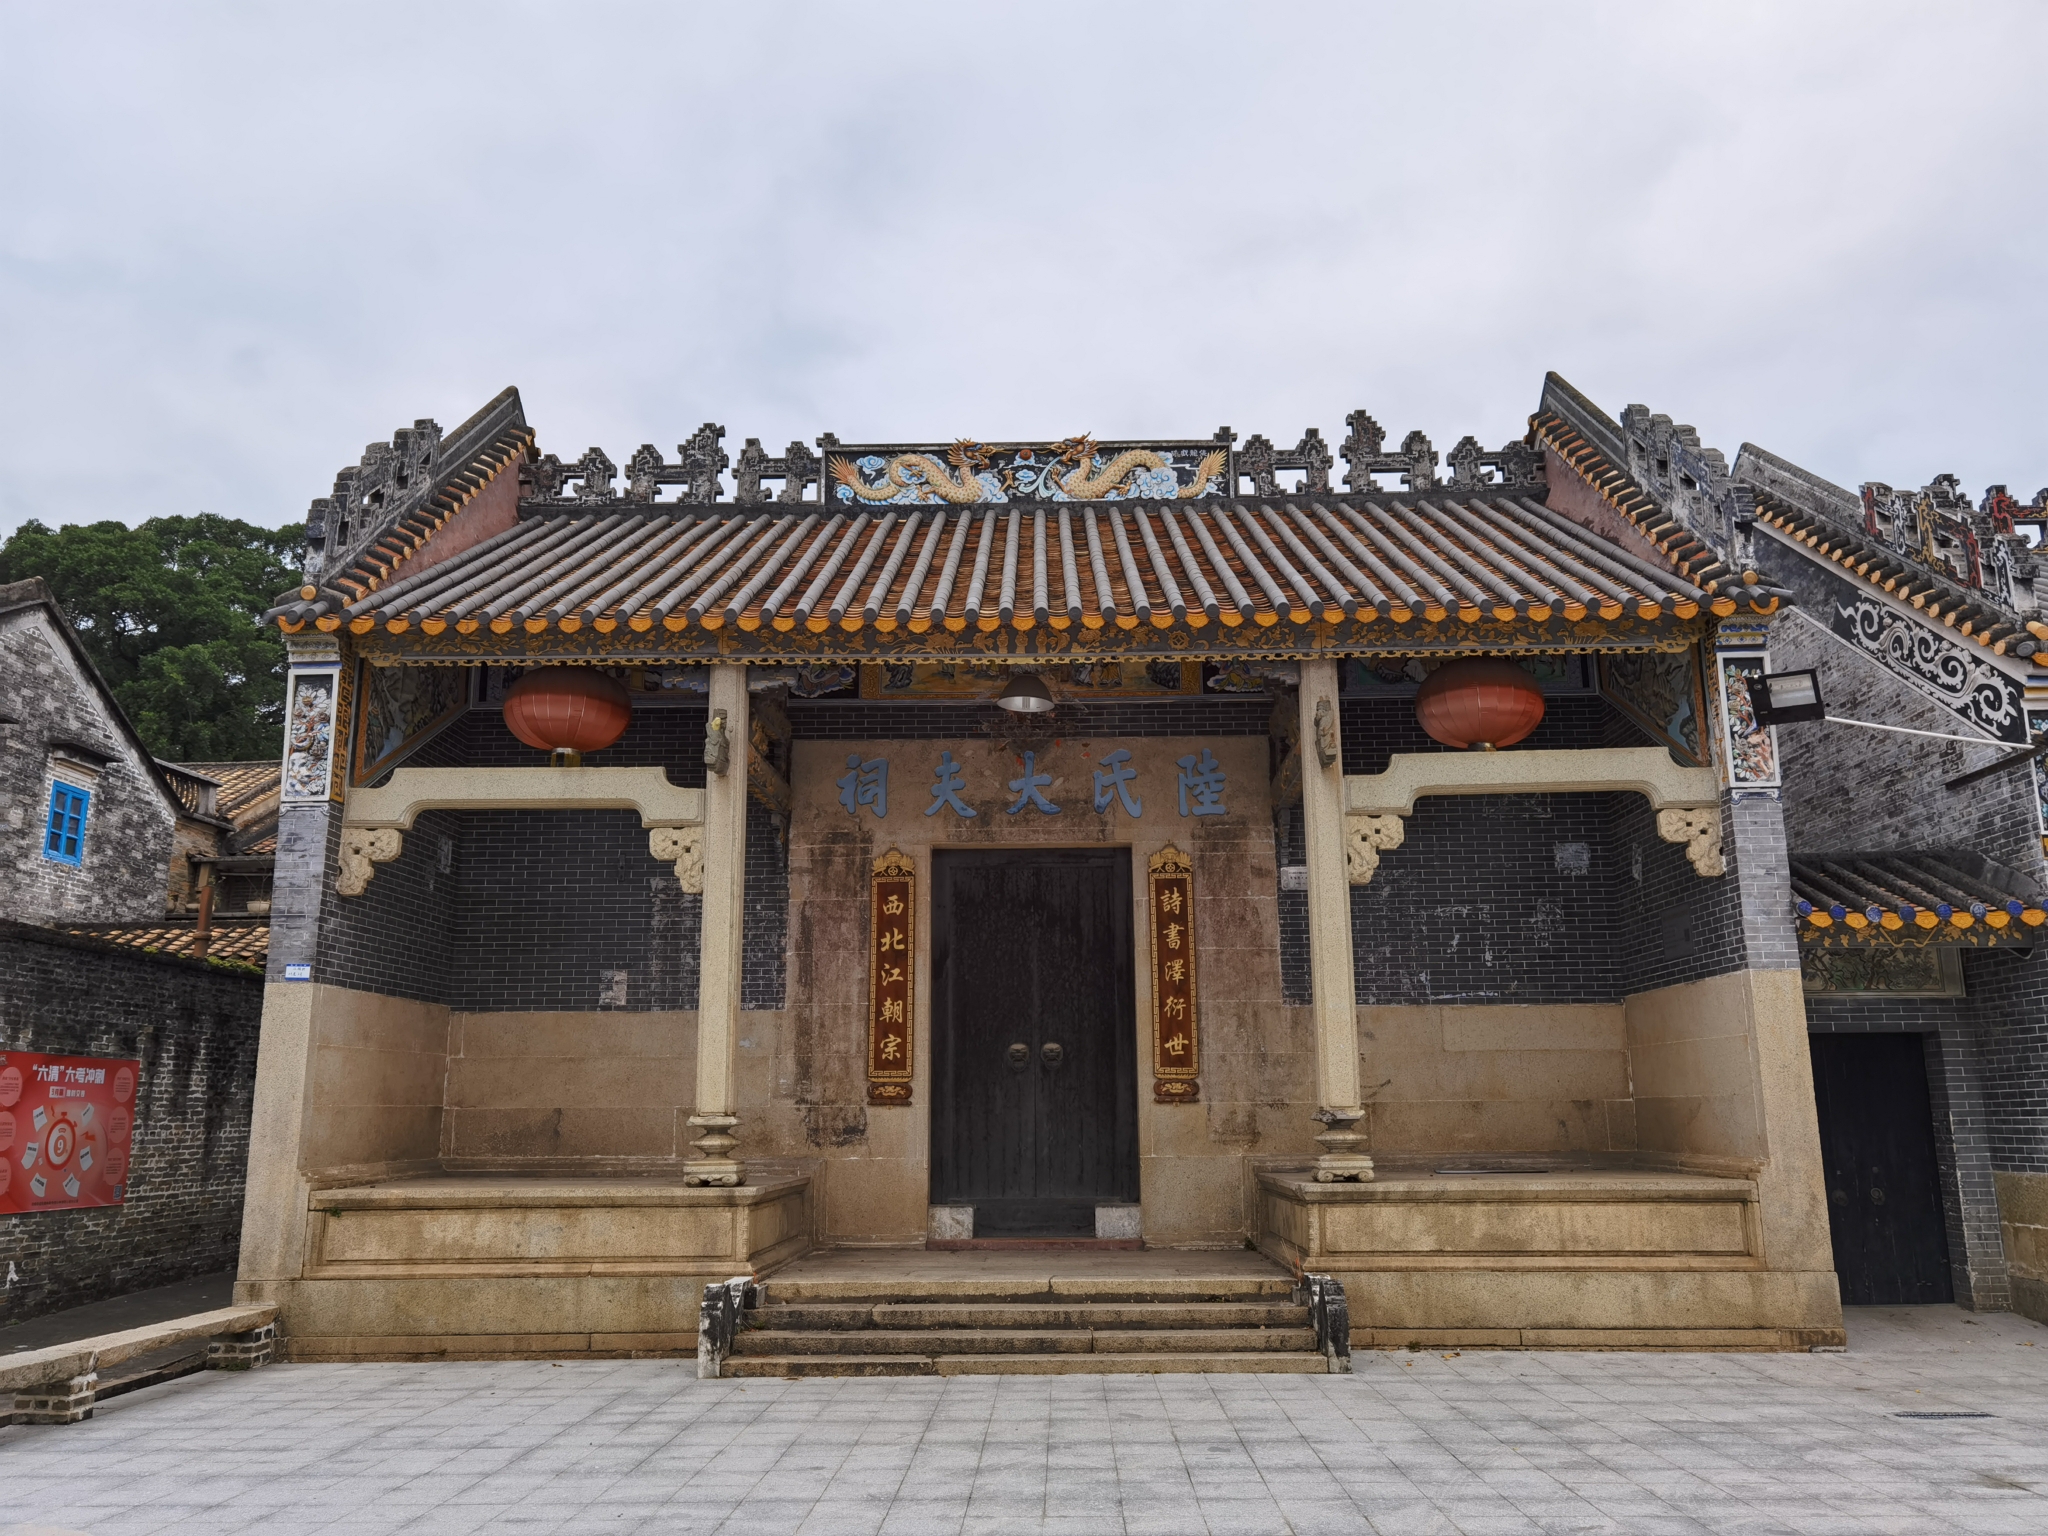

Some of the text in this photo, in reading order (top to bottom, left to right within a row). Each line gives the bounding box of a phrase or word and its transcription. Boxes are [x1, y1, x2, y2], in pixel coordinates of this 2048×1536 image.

[836, 748, 1227, 819] 陸氏大夫祠
[879, 894, 906, 1061] 西北江朝宗
[1160, 886, 1190, 1056] 詩書澤衍世
